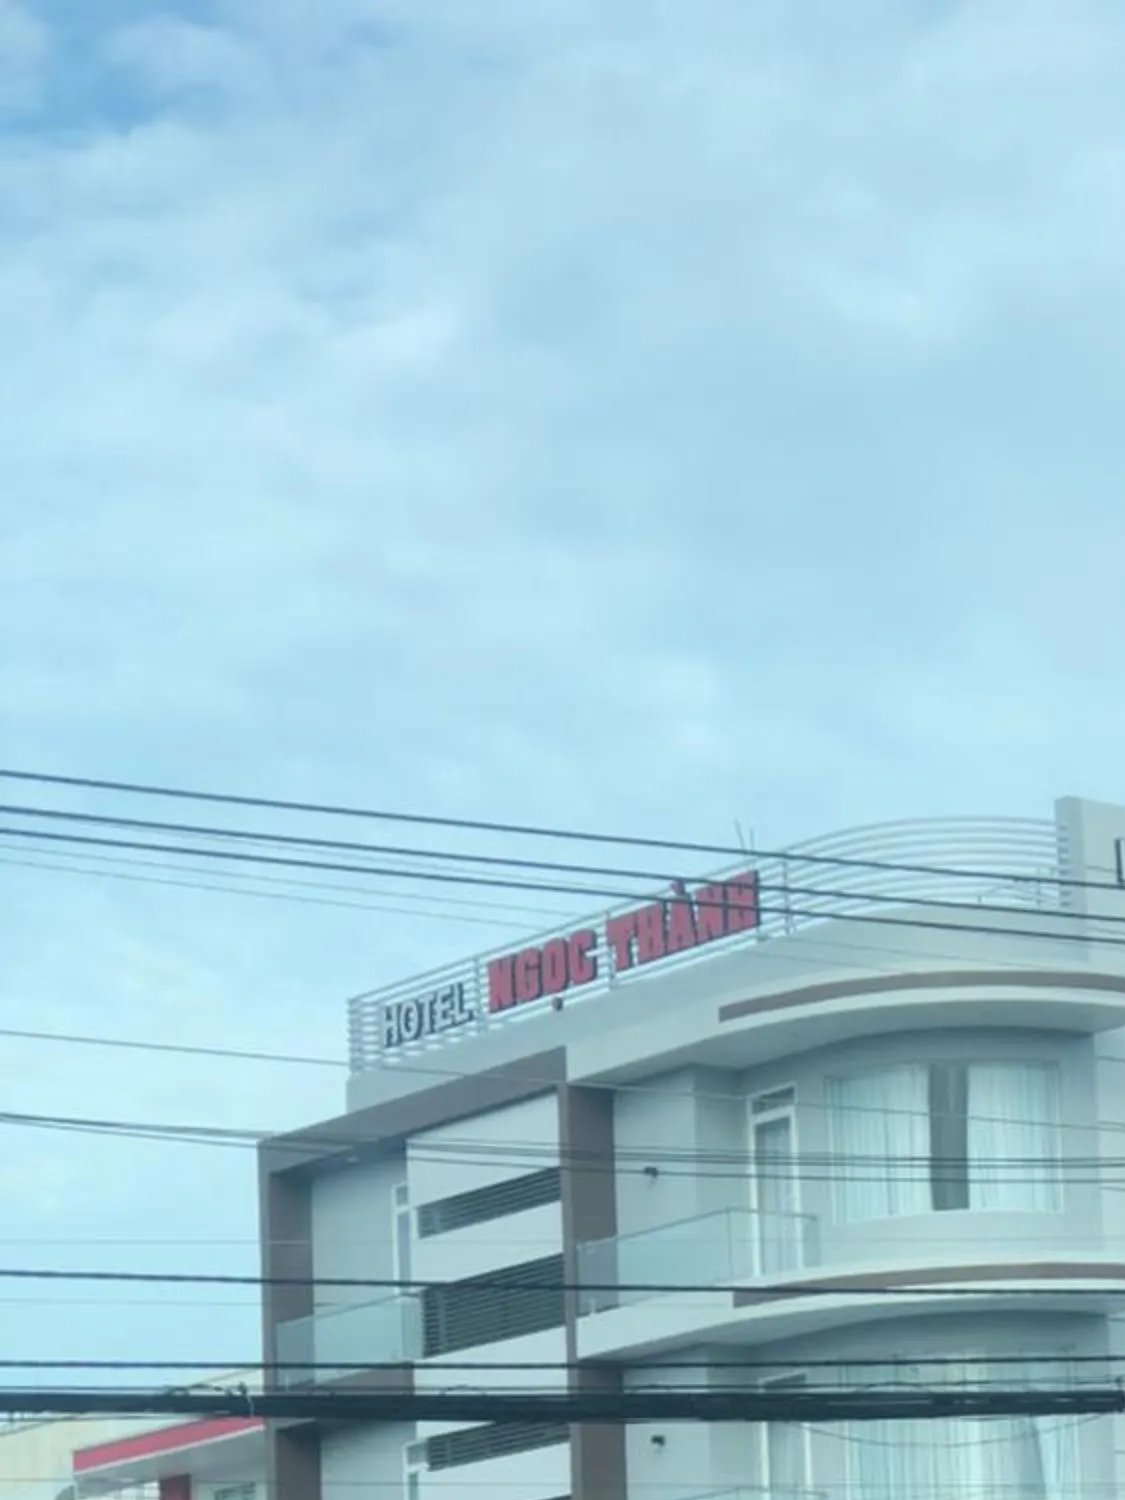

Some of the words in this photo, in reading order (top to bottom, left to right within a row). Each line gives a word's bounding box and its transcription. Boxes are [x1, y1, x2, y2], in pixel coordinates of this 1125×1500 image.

[384, 982, 475, 1048] HOTEL
[487, 928, 598, 1012] NGỌC
[606, 869, 760, 973] THÀNH
